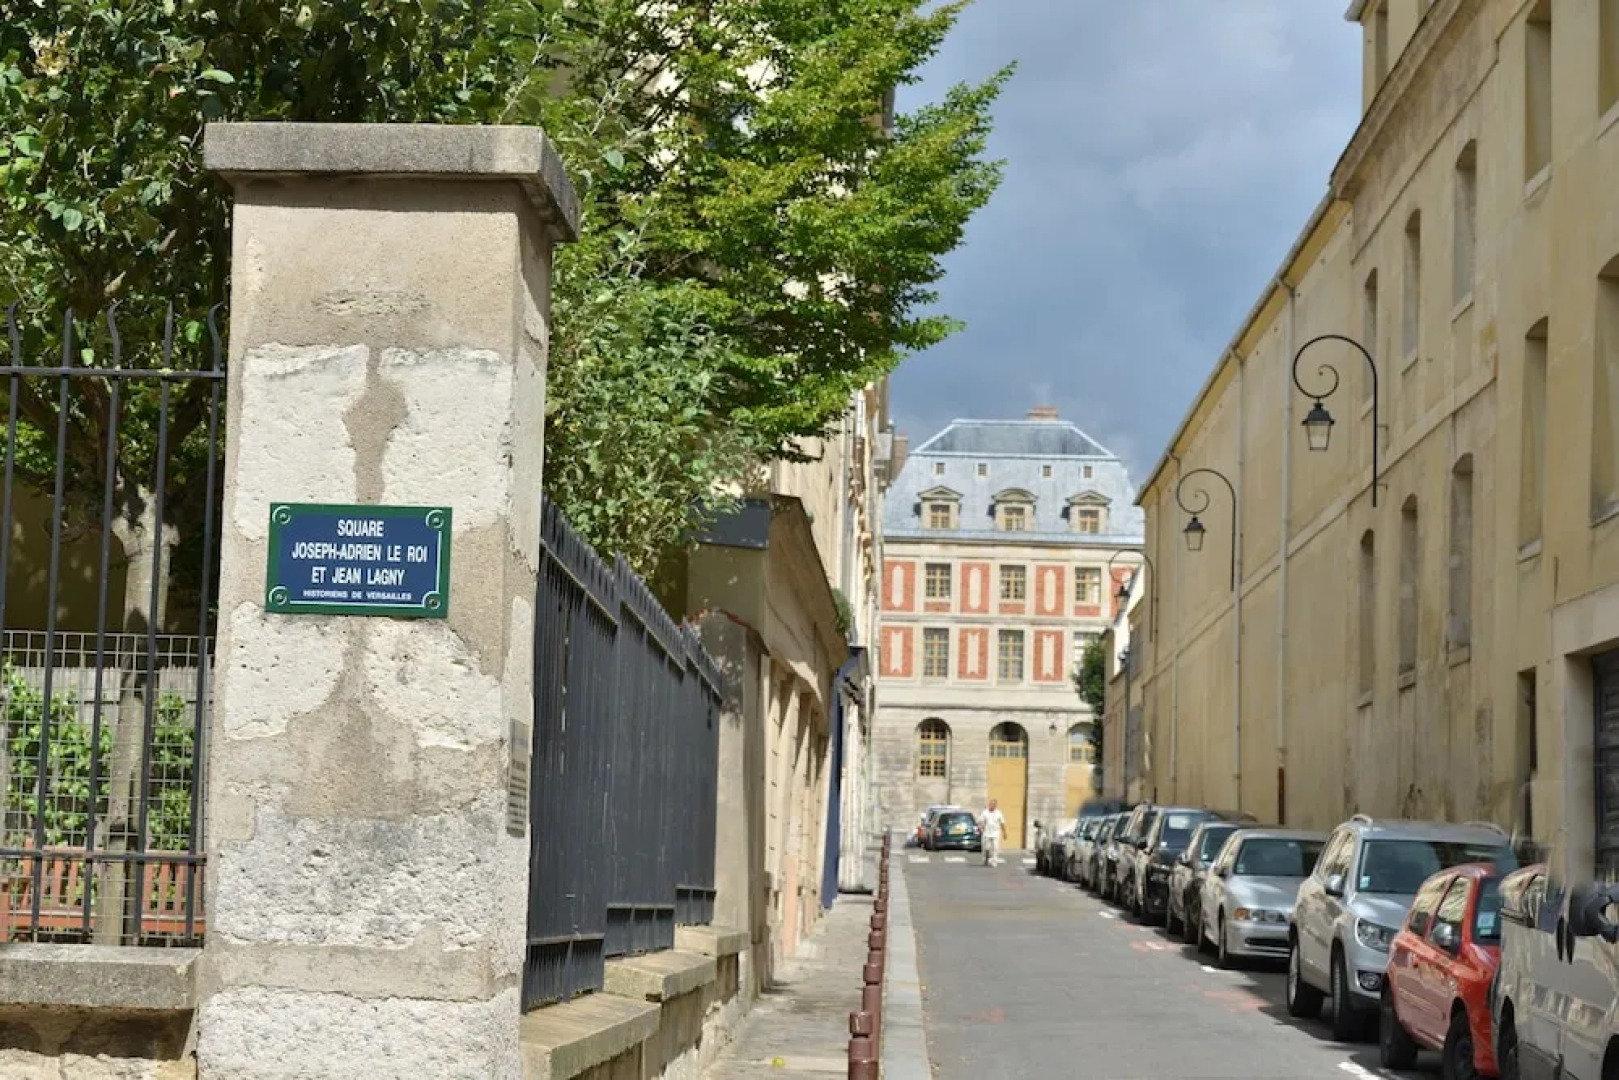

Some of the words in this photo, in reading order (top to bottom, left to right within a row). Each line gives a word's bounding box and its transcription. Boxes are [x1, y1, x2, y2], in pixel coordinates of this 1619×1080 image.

[337, 520, 384, 537] SQUARE
[292, 542, 381, 561] JOSEPH-ADRIEN
[387, 545, 401, 562] LE
[407, 546, 428, 563] ROI
[311, 566, 327, 584] ET
[332, 567, 361, 585] JEAN
[367, 569, 406, 586] LAGNY
[303, 590, 349, 599] HISTORIENS
[352, 591, 362, 600] DE
[366, 591, 412, 601] VERSAILLES
